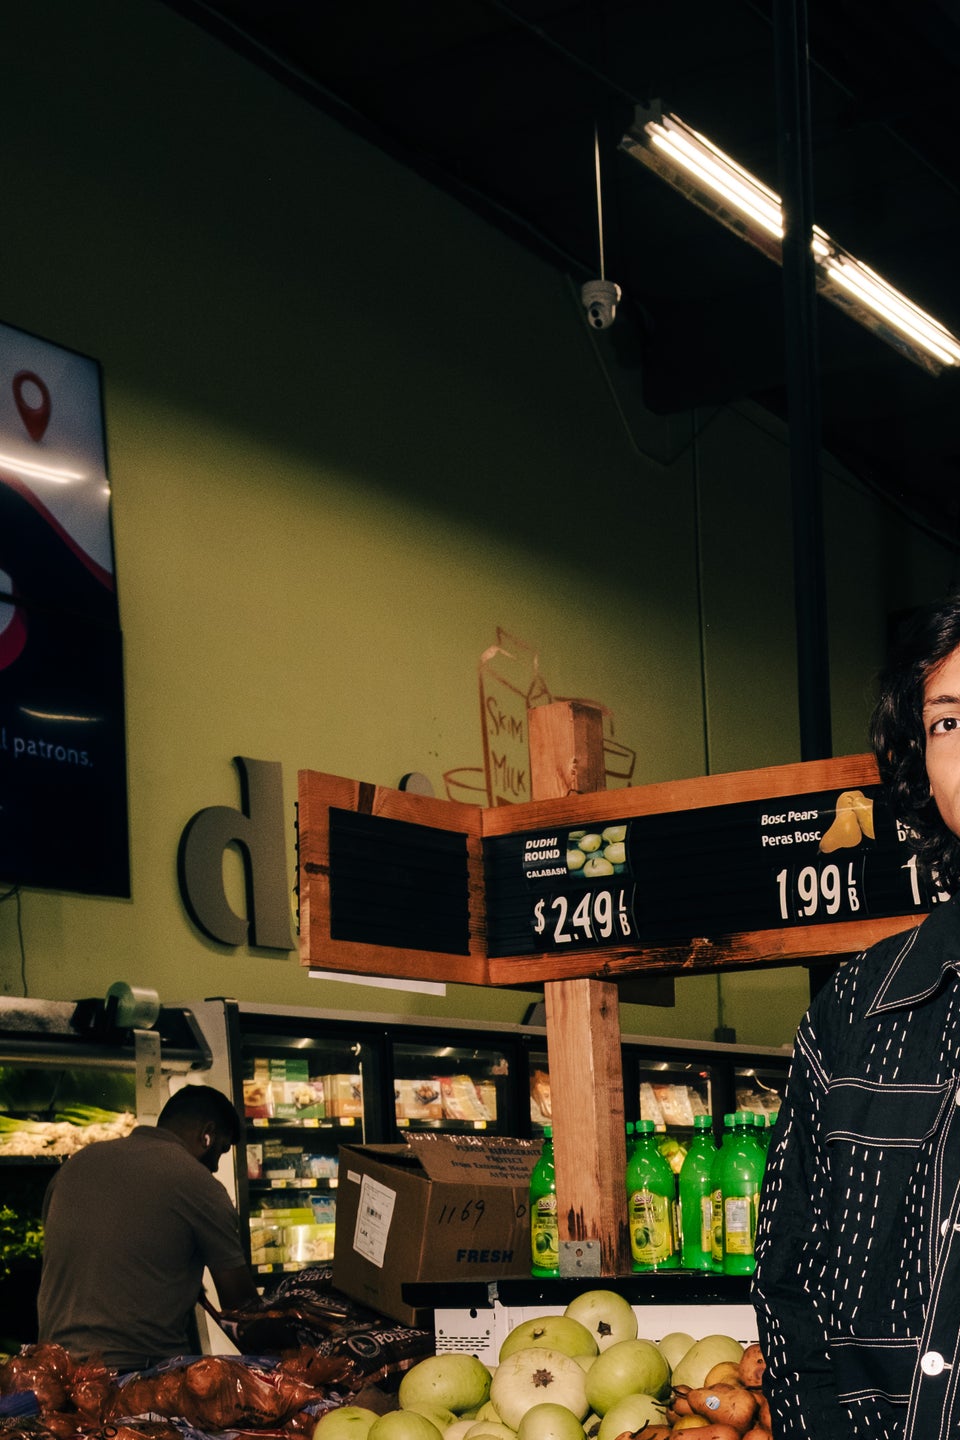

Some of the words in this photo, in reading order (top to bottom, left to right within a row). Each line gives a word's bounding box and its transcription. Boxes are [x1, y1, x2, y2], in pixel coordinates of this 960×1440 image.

[13, 737, 94, 768] patrons.
[761, 811, 786, 827] Bosc
[787, 807, 820, 823] Pears
[525, 838, 558, 850] DUDHI
[762, 833, 794, 848] Peras
[795, 829, 822, 844] Bosc
[524, 849, 561, 862] ROUND
[526, 867, 567, 879] CALABASH
[776, 863, 841, 920] 1.99
[438, 1200, 485, 1231] 1169
[456, 1249, 514, 1263] FRESH
